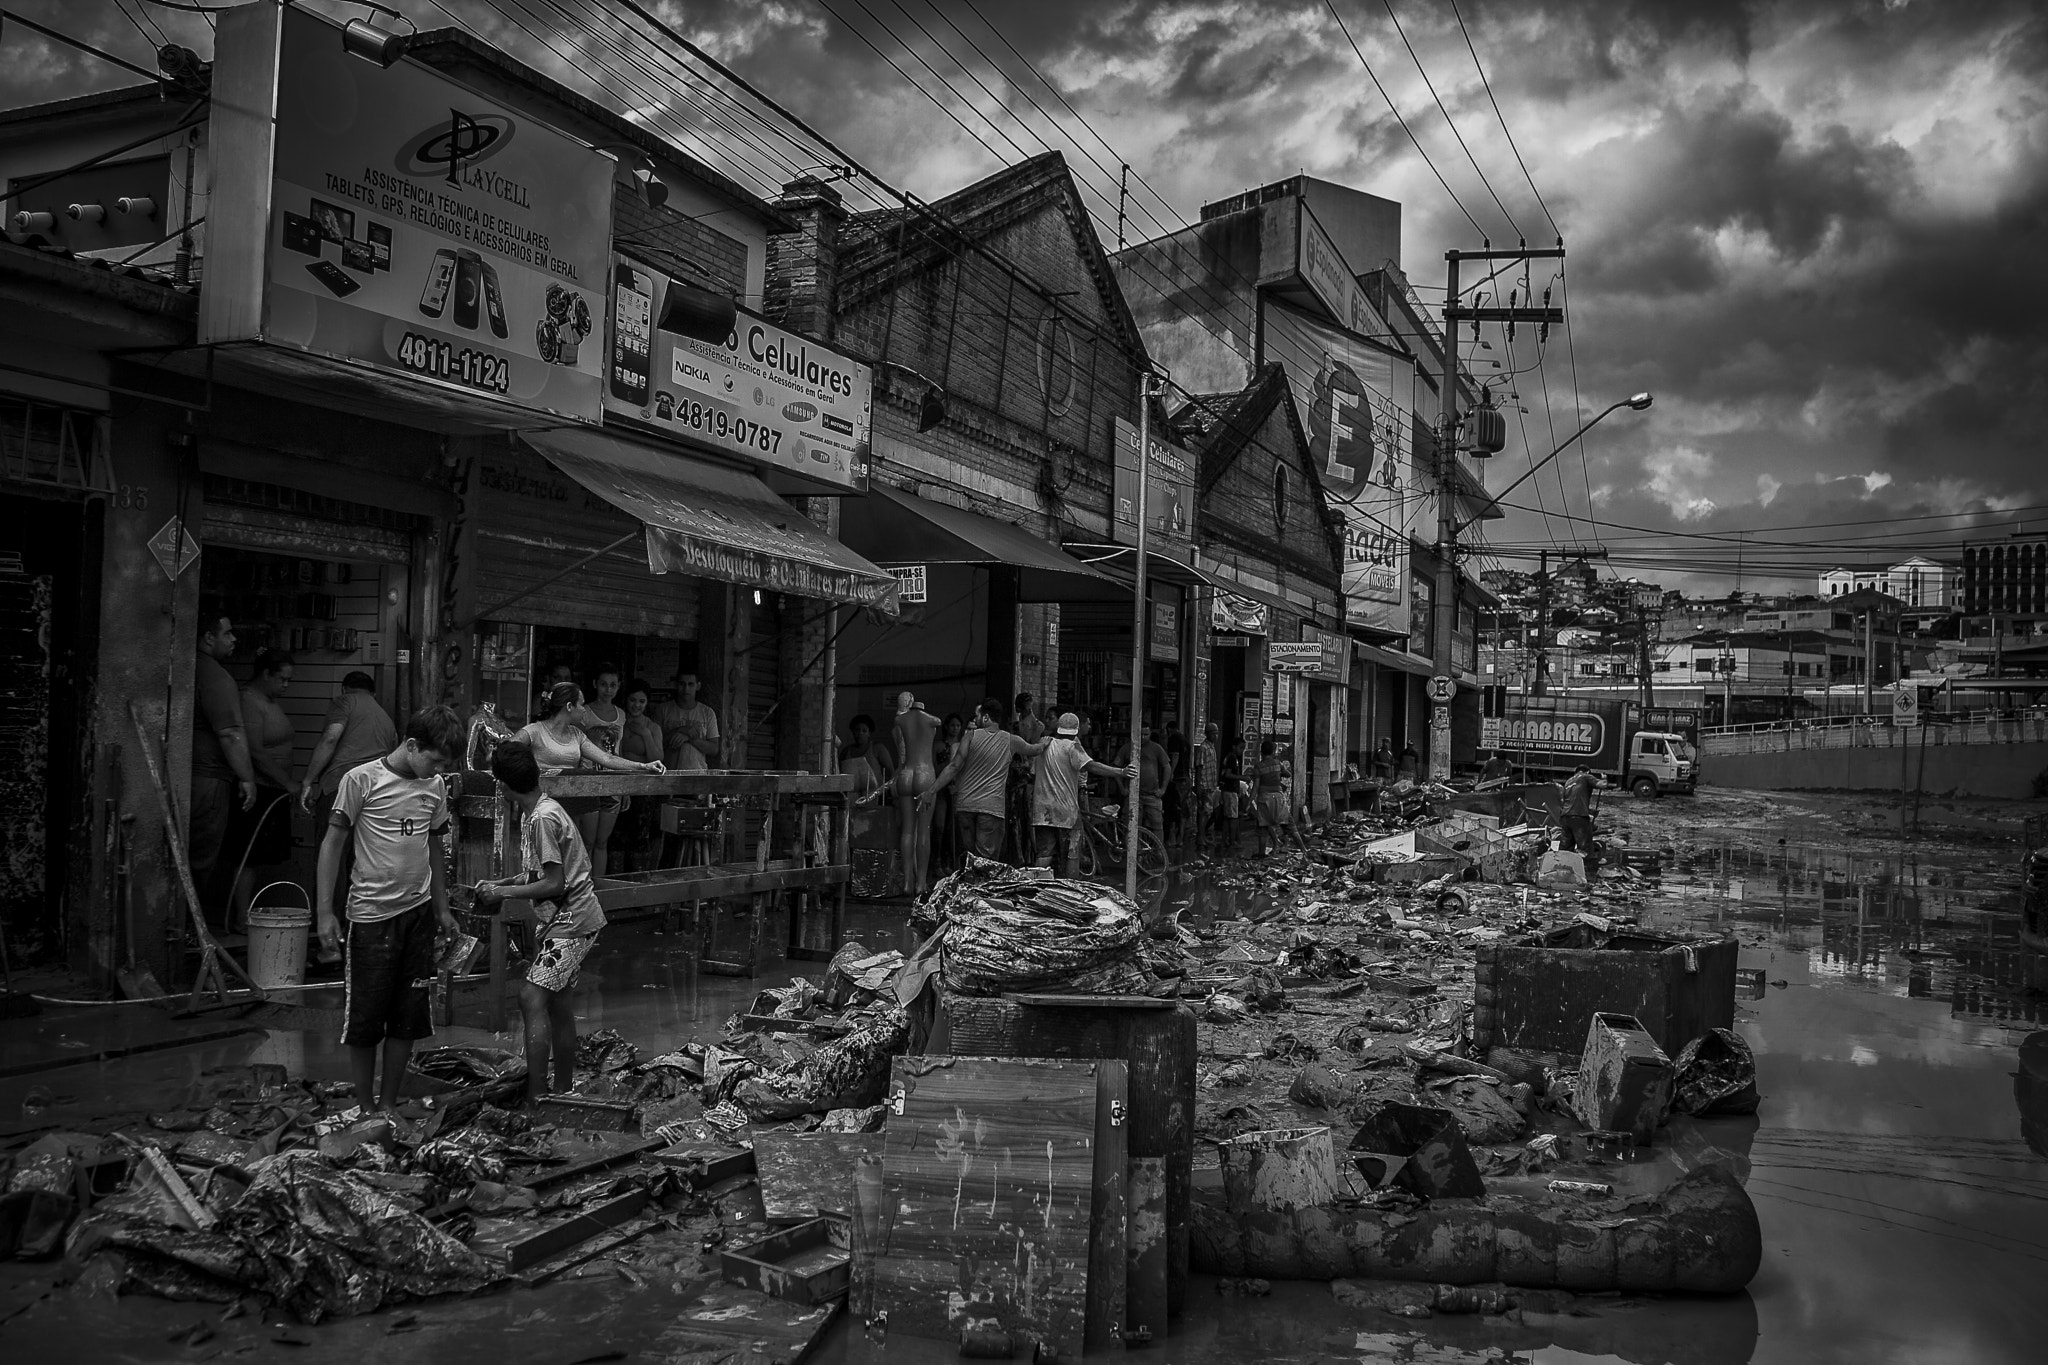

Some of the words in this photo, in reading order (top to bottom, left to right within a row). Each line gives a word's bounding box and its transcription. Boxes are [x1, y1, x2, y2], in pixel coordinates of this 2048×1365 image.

[325, 172, 378, 209] TABLETS,
[382, 194, 407, 219] GPS,
[410, 205, 461, 237] RELÓGIOS
[464, 225, 471, 241] E
[473, 229, 532, 263] ACESSÓRIOS
[534, 251, 548, 269] EM
[550, 257, 578, 280] GERAL
[364, 167, 435, 208] ASSISTÊNCIA
[438, 195, 479, 225] TÉCNICA
[482, 213, 495, 231] DE
[497, 218, 552, 254] CELULARES,
[399, 333, 508, 392] 4811-1124
[675, 360, 711, 384] NOKIA
[689, 338, 731, 364] Assistência
[733, 355, 761, 377] Técnica
[762, 370, 768, 379] e
[768, 371, 804, 393] Acessórios
[805, 388, 816, 398] em
[817, 388, 835, 405] Geral
[748, 325, 852, 397] Celulares
[676, 397, 783, 454] 4819-0787
[786, 403, 815, 420] SAMSUNG
[830, 420, 852, 432] MOTOROLA
[1149, 441, 1185, 473] Celulares
[1326, 387, 1360, 484] E
[685, 540, 761, 580] Desbloqueio
[780, 560, 833, 593] Celulares
[1343, 525, 1397, 569] nada
[888, 567, 923, 579] OMPRA-SE
[1270, 645, 1321, 653] ESTACIONAMENTO
[1500, 719, 1592, 743] ARABRAZ
[400, 818, 413, 836] 10
